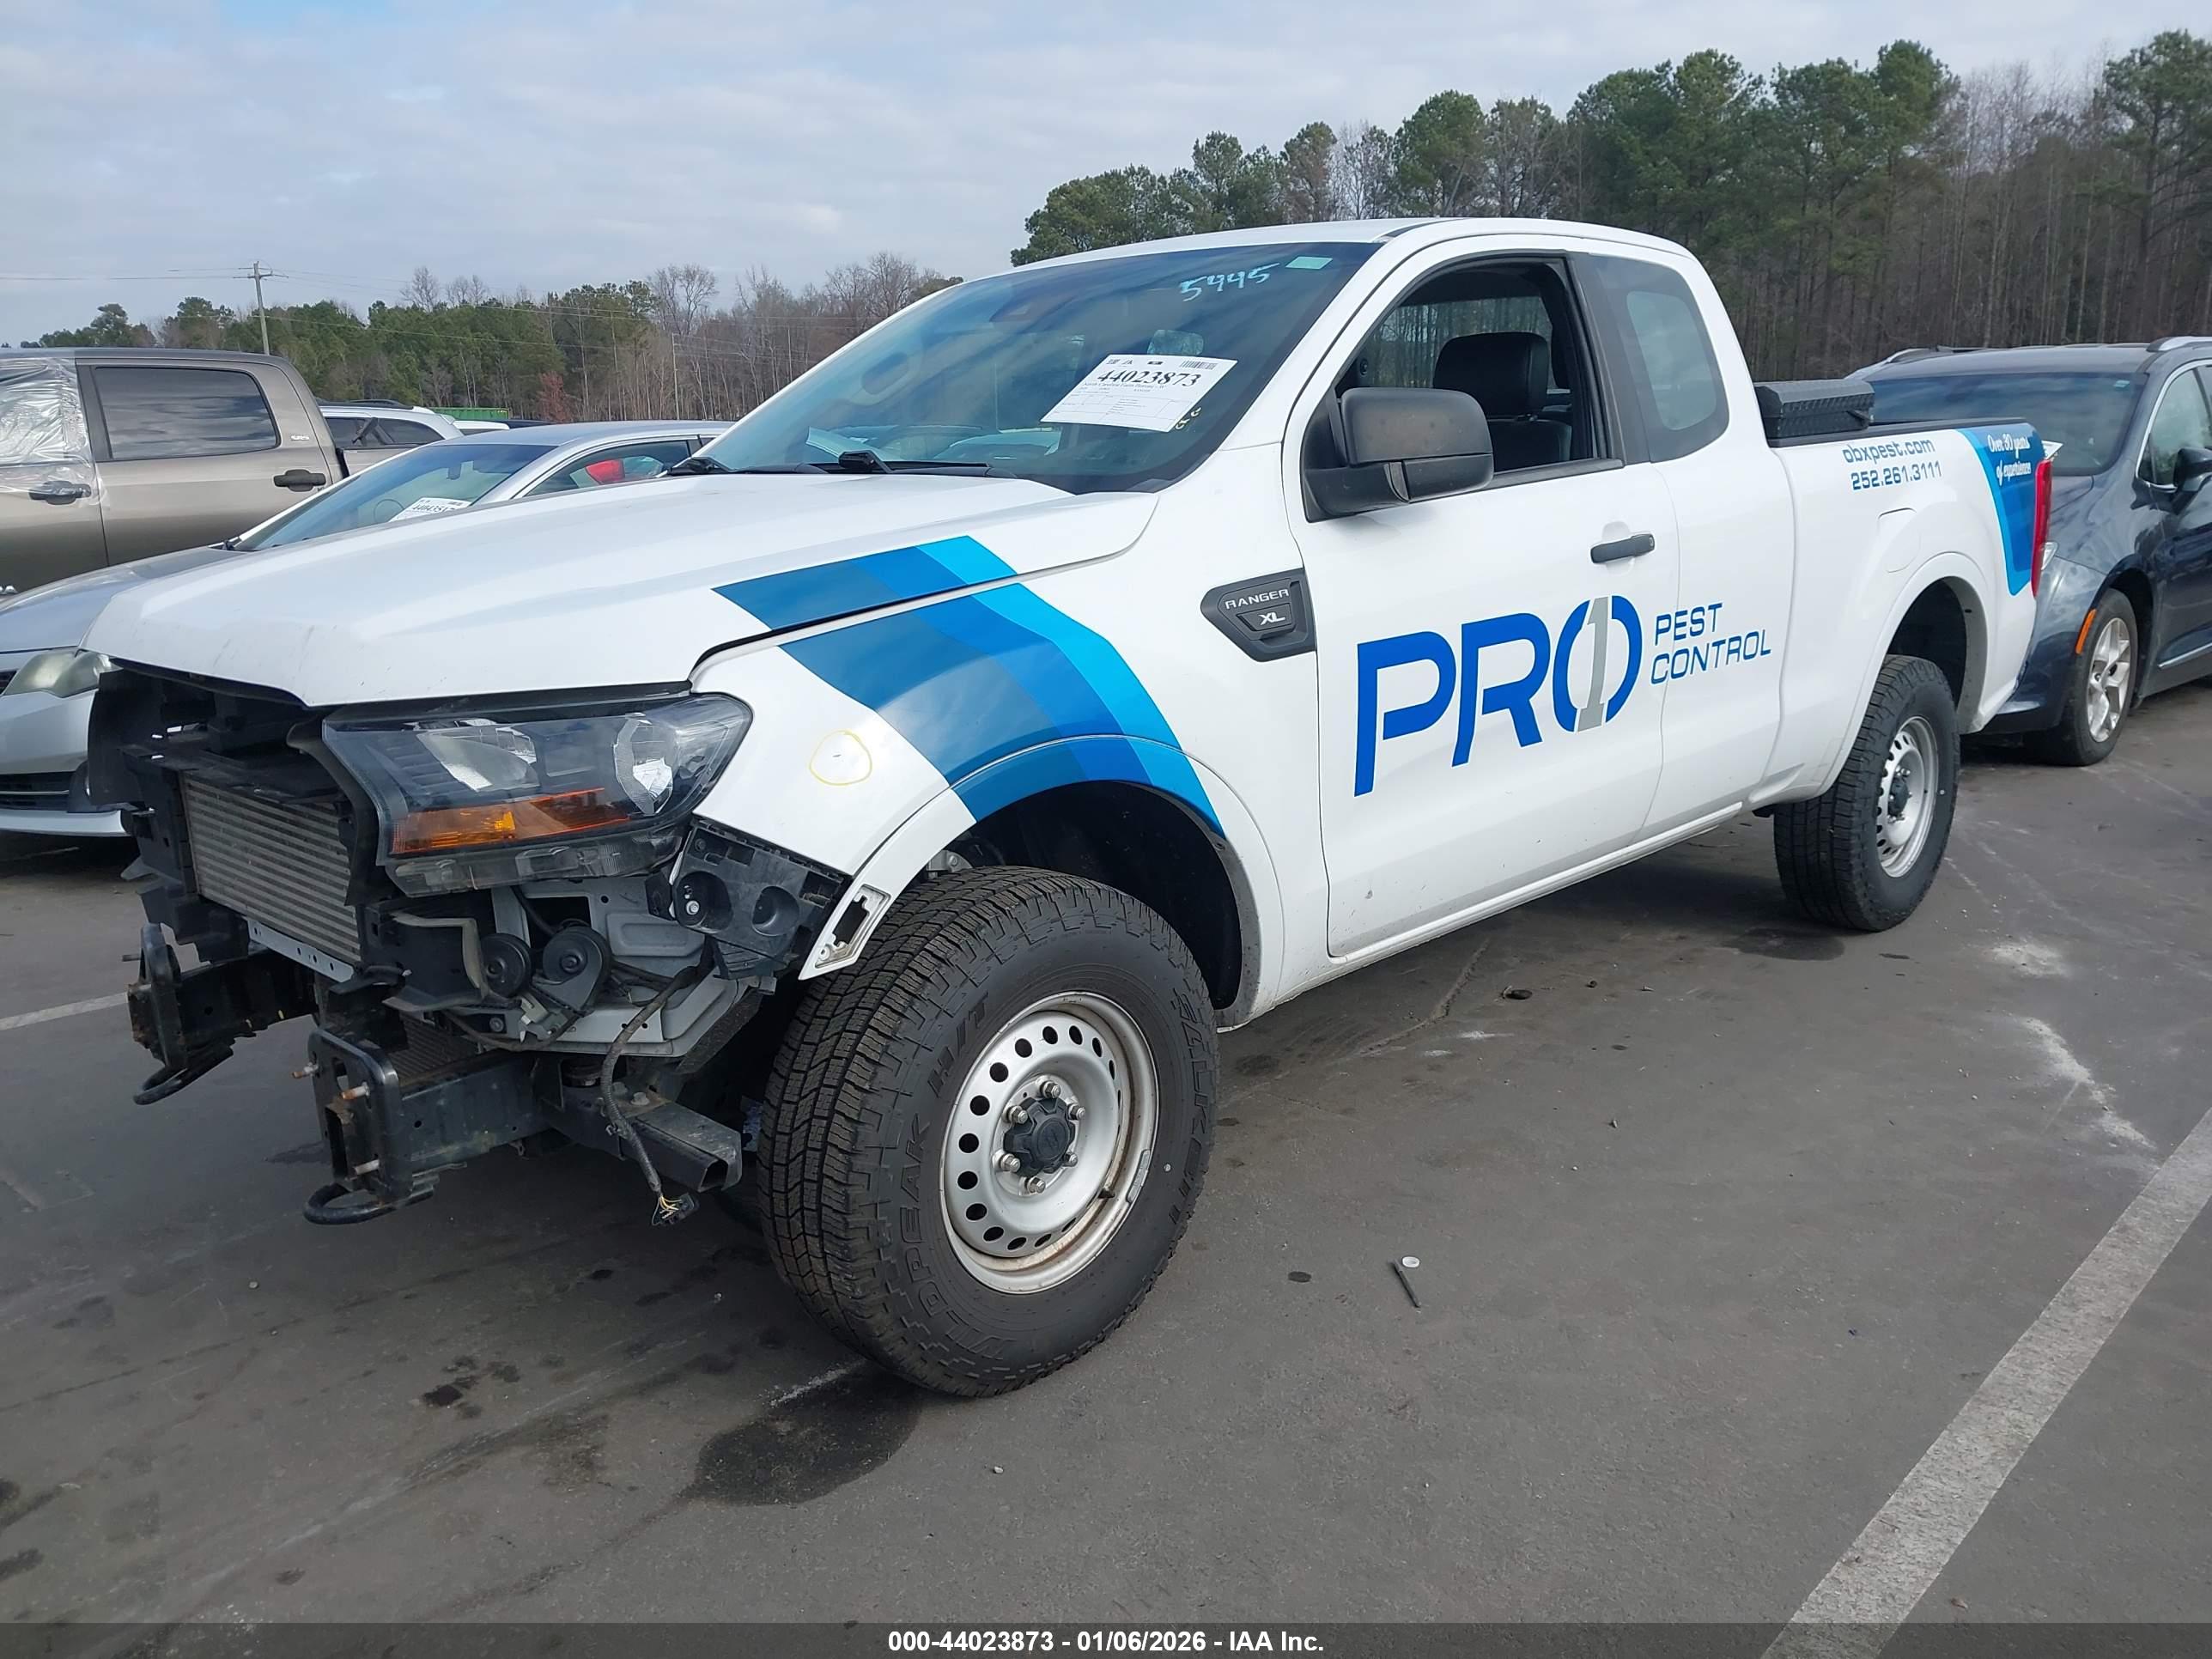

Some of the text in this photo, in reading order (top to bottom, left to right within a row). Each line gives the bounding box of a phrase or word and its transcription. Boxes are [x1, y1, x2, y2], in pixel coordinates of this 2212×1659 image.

[1097, 369, 1202, 387] 44023873
[1842, 440, 1936, 464] obxpest.com
[1850, 460, 1942, 490] 252.261.3111
[1224, 588, 1290, 610] RANGER
[1258, 611, 1286, 625] XL
[1655, 602, 1723, 646] PEST
[1650, 629, 1771, 684] CONTROL
